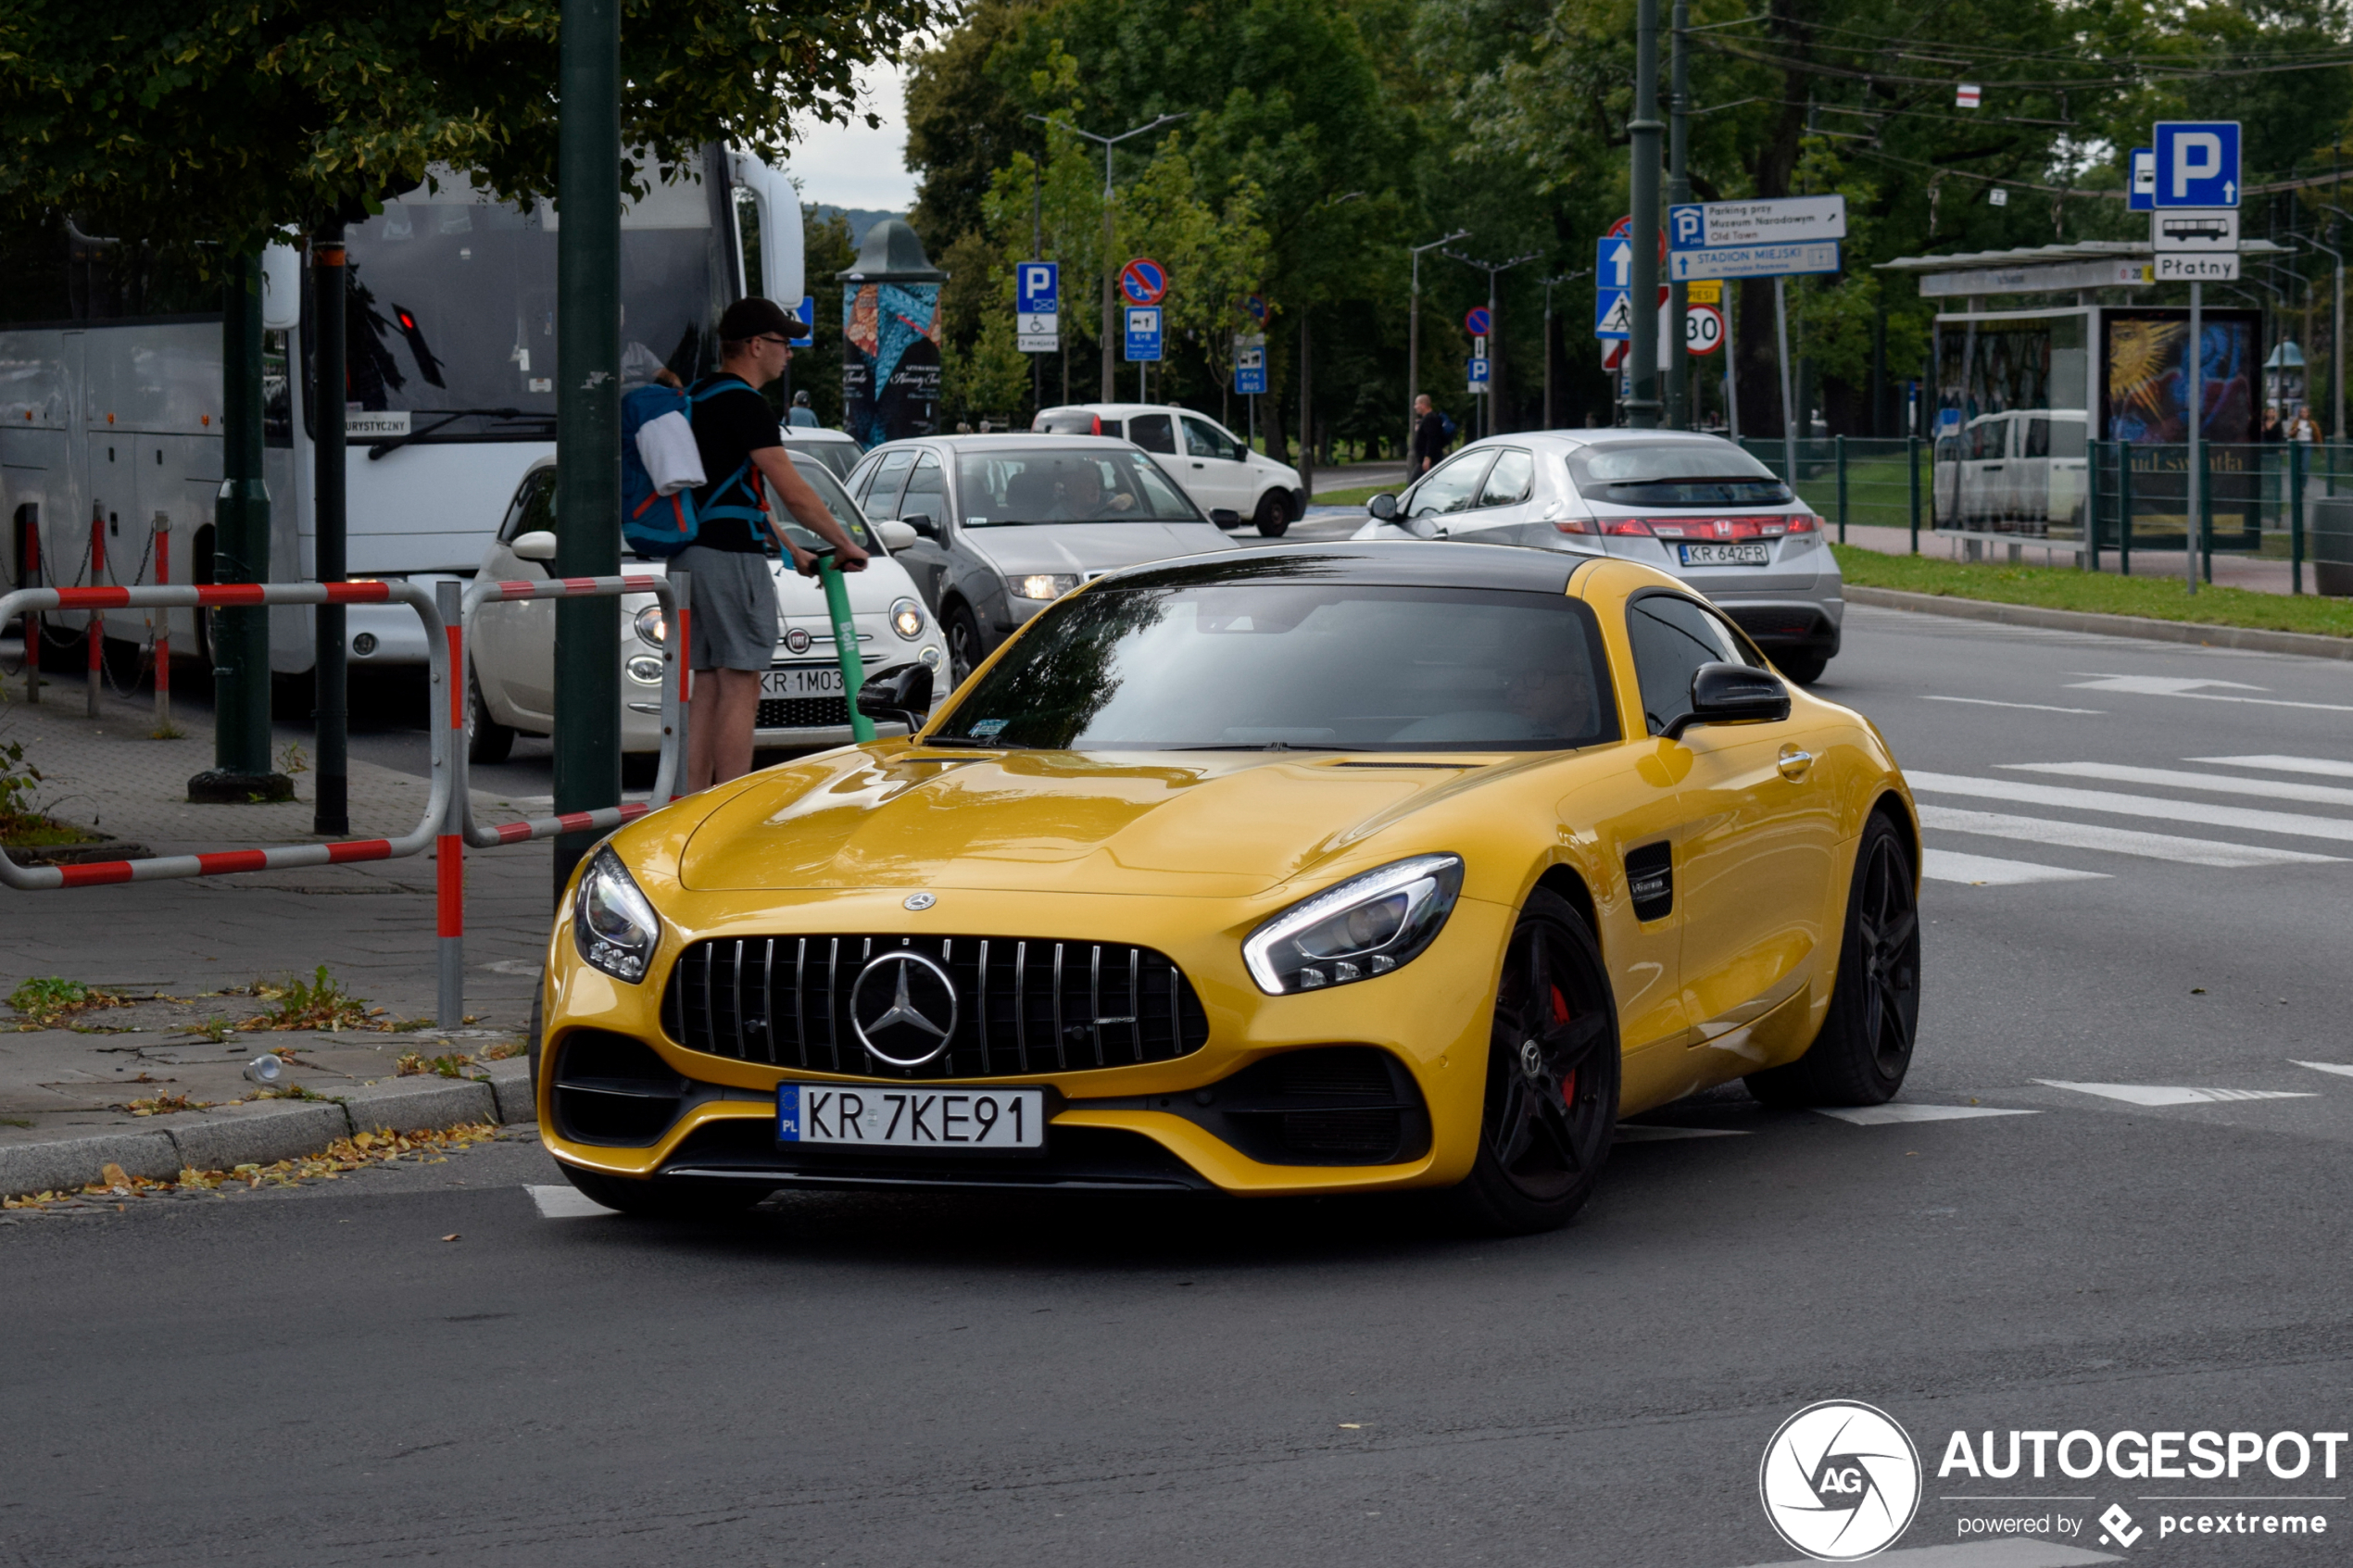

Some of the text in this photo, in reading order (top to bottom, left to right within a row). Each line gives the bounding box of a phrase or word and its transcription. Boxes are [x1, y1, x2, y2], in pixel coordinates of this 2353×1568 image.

[2172, 132, 2221, 197] P
[1708, 206, 1771, 217] Parking przy
[1678, 216, 1698, 243] P
[1709, 219, 1752, 229] Muzeum
[1710, 231, 1758, 242] Old Town
[1697, 247, 1802, 264] STADION MIEJSKI
[2162, 259, 2233, 279] Płatny
[1026, 267, 1050, 299] P
[1686, 317, 1718, 341] 30
[1473, 361, 1487, 379] P
[1241, 382, 1261, 391] BUS
[346, 420, 405, 432] URYSTYCZNY
[1689, 546, 1765, 561] KR 642FR
[792, 635, 805, 646] FIAT
[838, 621, 857, 652] Bolt
[761, 671, 843, 693] KR 1M03
[809, 1091, 1024, 1143] KR 7KE91
[782, 1119, 798, 1133] PL
